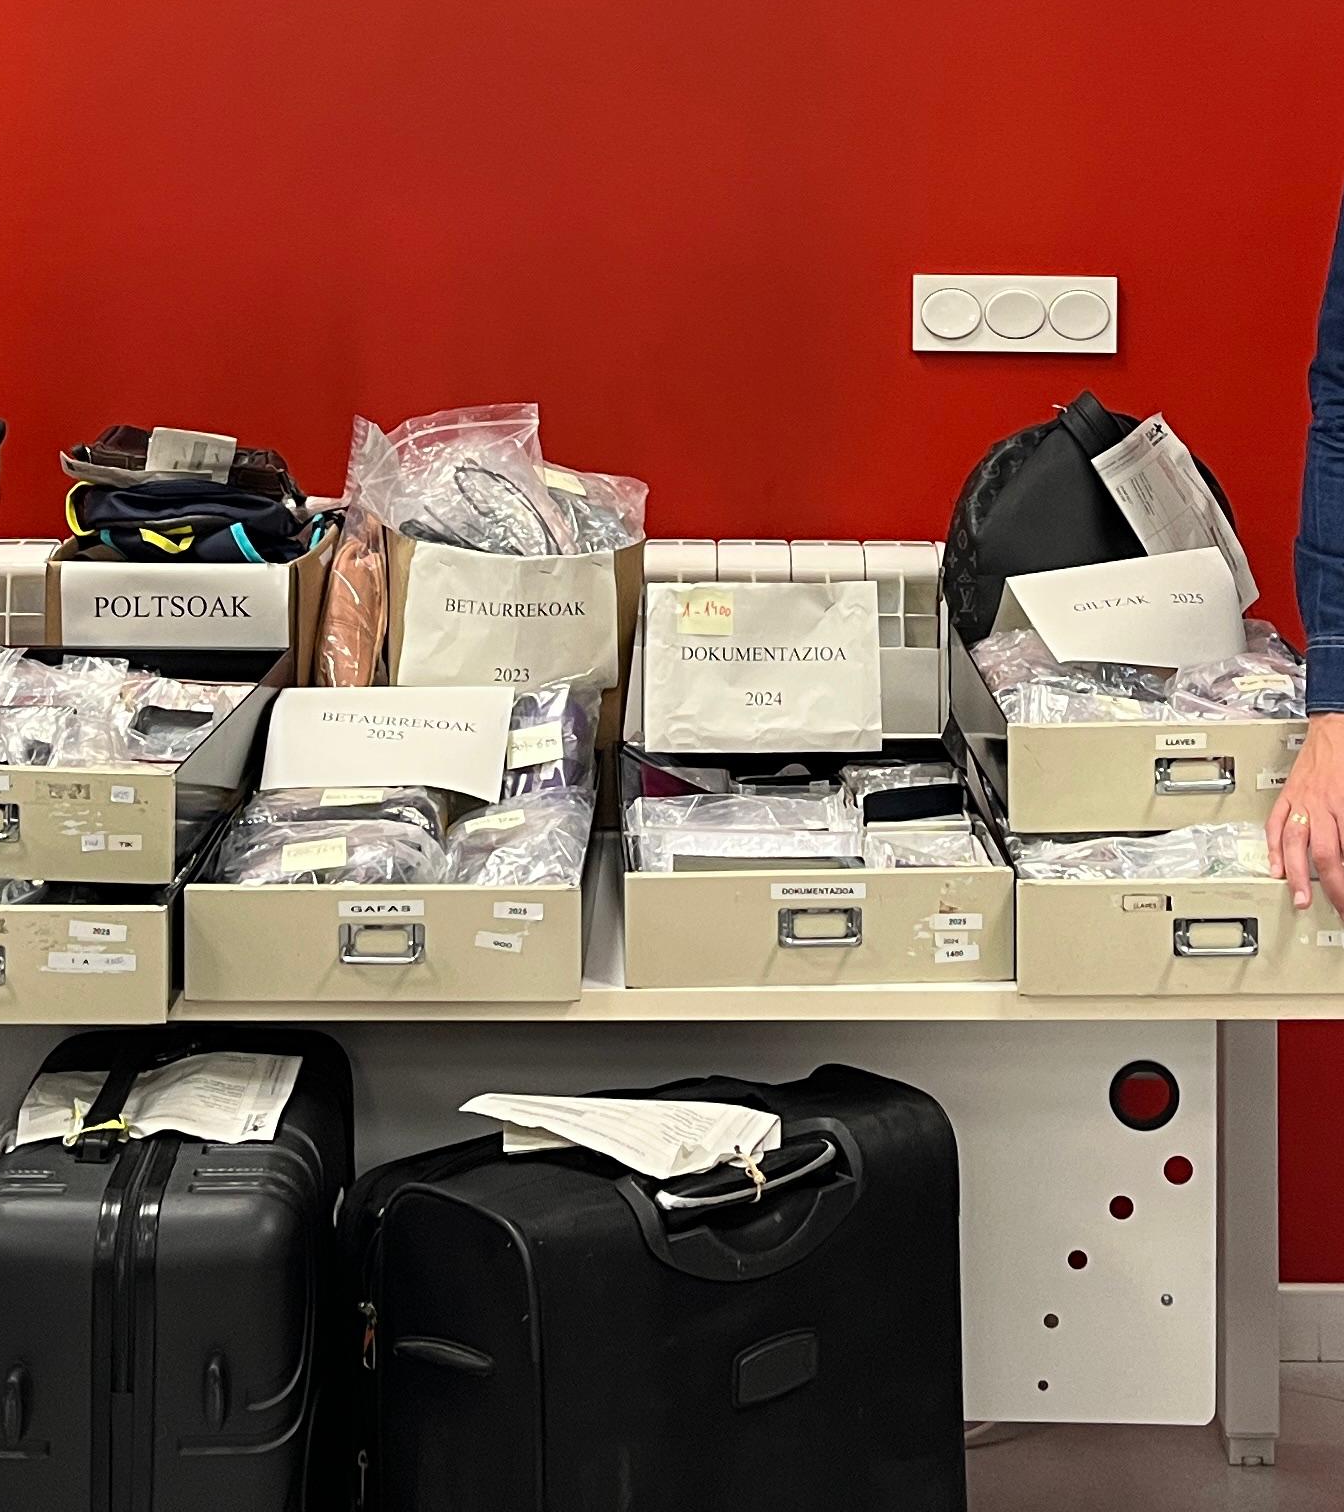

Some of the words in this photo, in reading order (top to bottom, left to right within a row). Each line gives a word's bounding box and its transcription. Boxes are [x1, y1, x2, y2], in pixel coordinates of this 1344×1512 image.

[93, 595, 251, 619] POLTSOAK
[445, 597, 586, 617] BETAURREKOAK
[1073, 594, 1152, 613] GILTZAK
[1170, 593, 1204, 605] 2025
[681, 646, 847, 663] DOKUMENTAZIOA
[493, 667, 531, 683] 2023
[744, 691, 783, 707] 2024
[321, 711, 477, 733] BETAURREKOAK
[366, 728, 405, 741] 2025
[781, 887, 855, 895] DOKUMENTAZIOA
[350, 905, 412, 913] GAFAS
